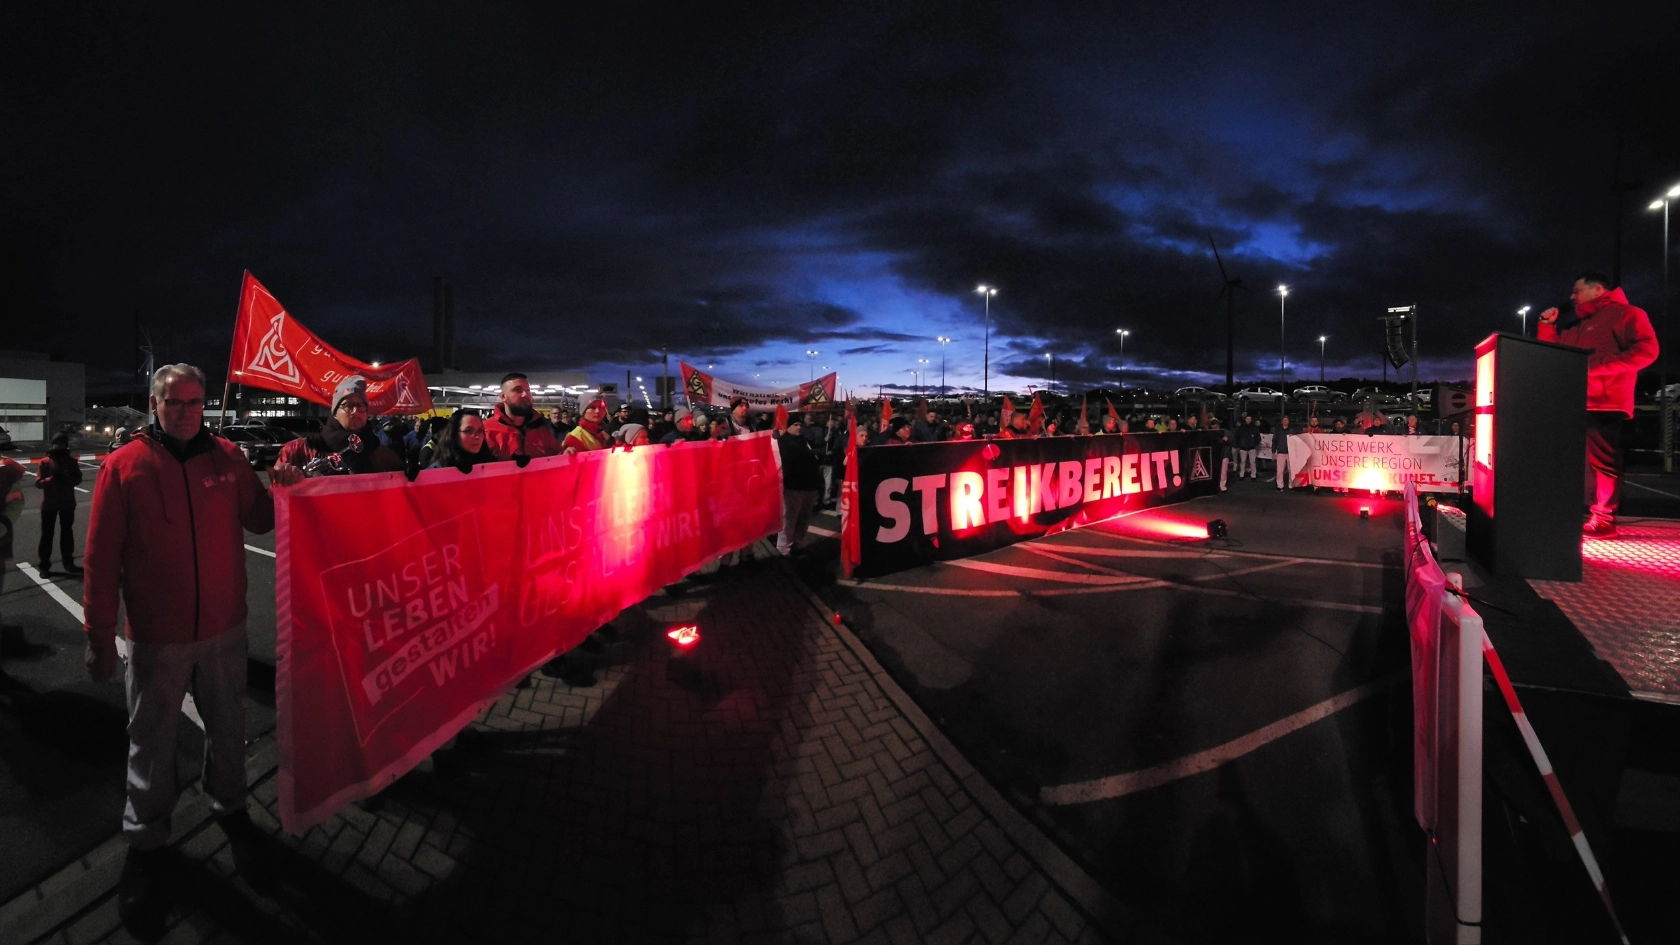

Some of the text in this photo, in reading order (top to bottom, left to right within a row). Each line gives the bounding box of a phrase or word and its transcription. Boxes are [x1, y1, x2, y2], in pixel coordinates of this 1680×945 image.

[1313, 439, 1354, 452] UNSER
[1373, 457, 1422, 470] REGION
[875, 450, 1182, 543] STREIKBEREIT!
[348, 543, 462, 618] UNSER
[363, 574, 470, 653] LEBEN
[370, 591, 496, 697] gestalten
[429, 623, 497, 687] WIR!
